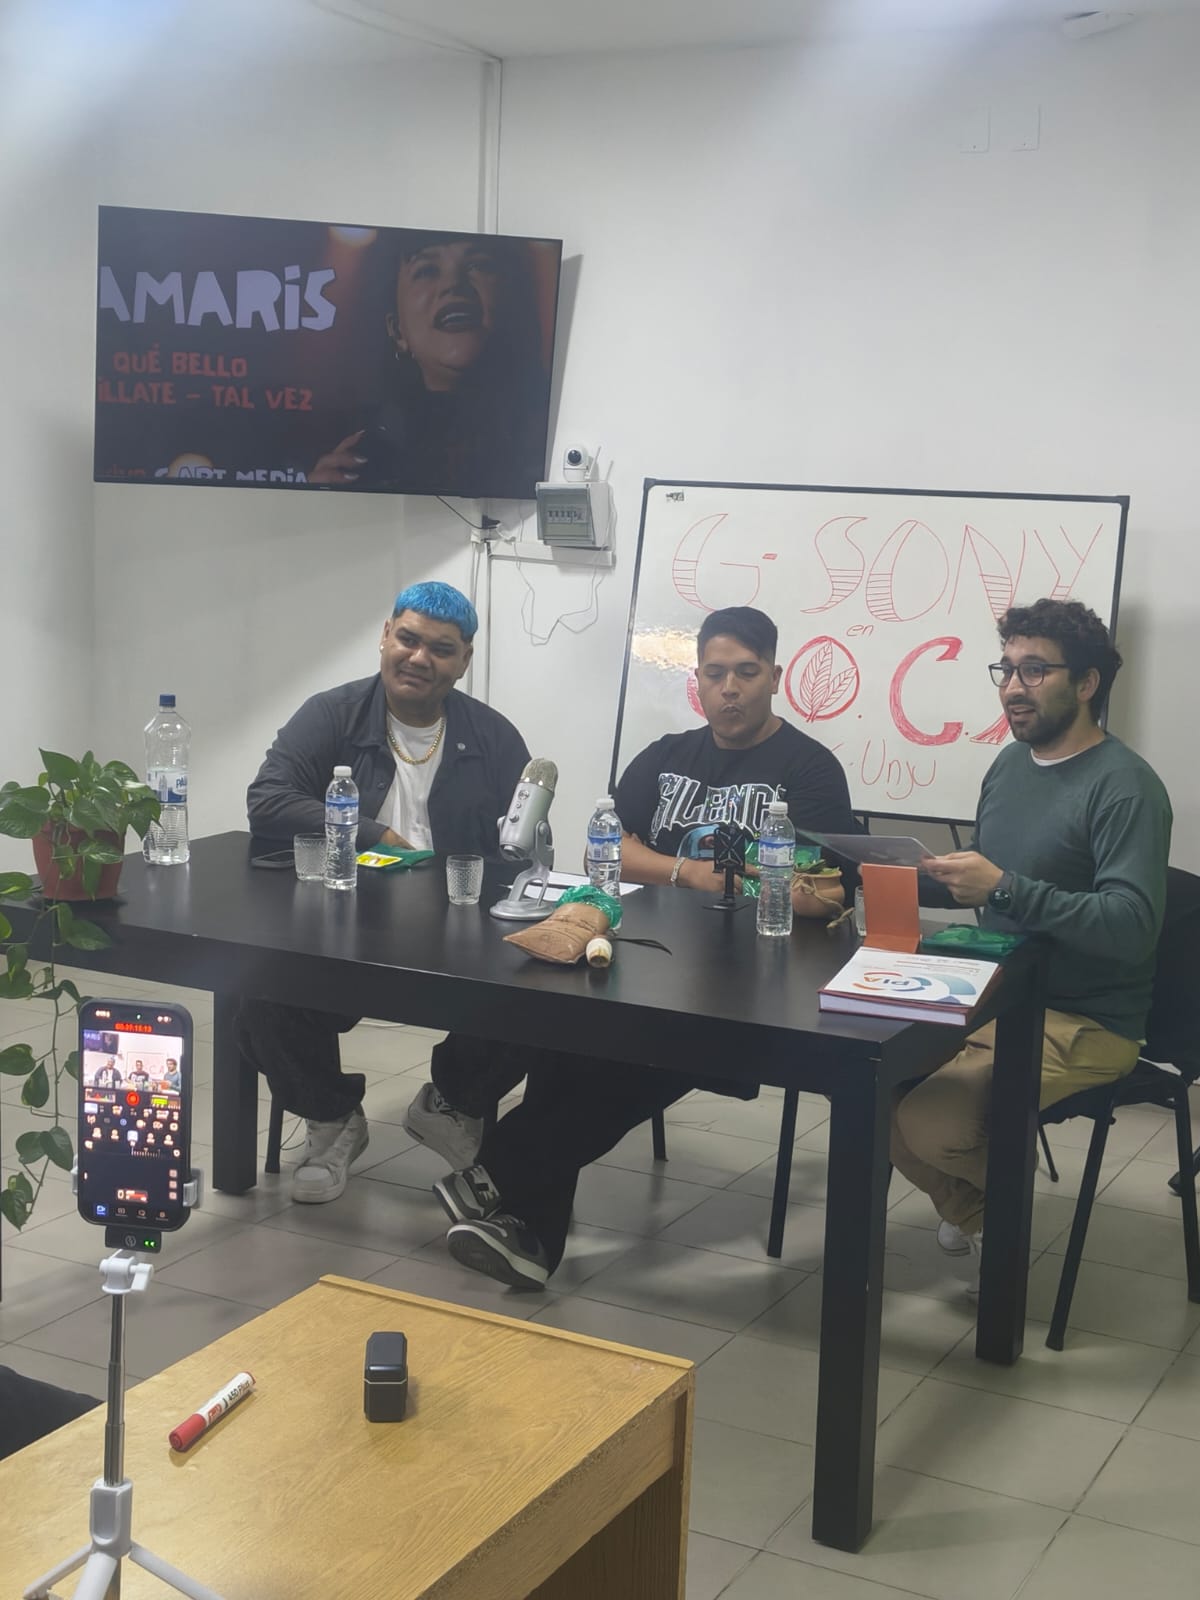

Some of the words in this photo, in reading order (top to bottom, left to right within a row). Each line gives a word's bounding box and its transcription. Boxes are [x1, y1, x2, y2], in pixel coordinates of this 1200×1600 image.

[112, 343, 162, 374] QUÉ
[171, 351, 248, 377] BELLO
[211, 385, 256, 408] TAL
[264, 387, 313, 411] VEZ
[846, 624, 874, 636] en
